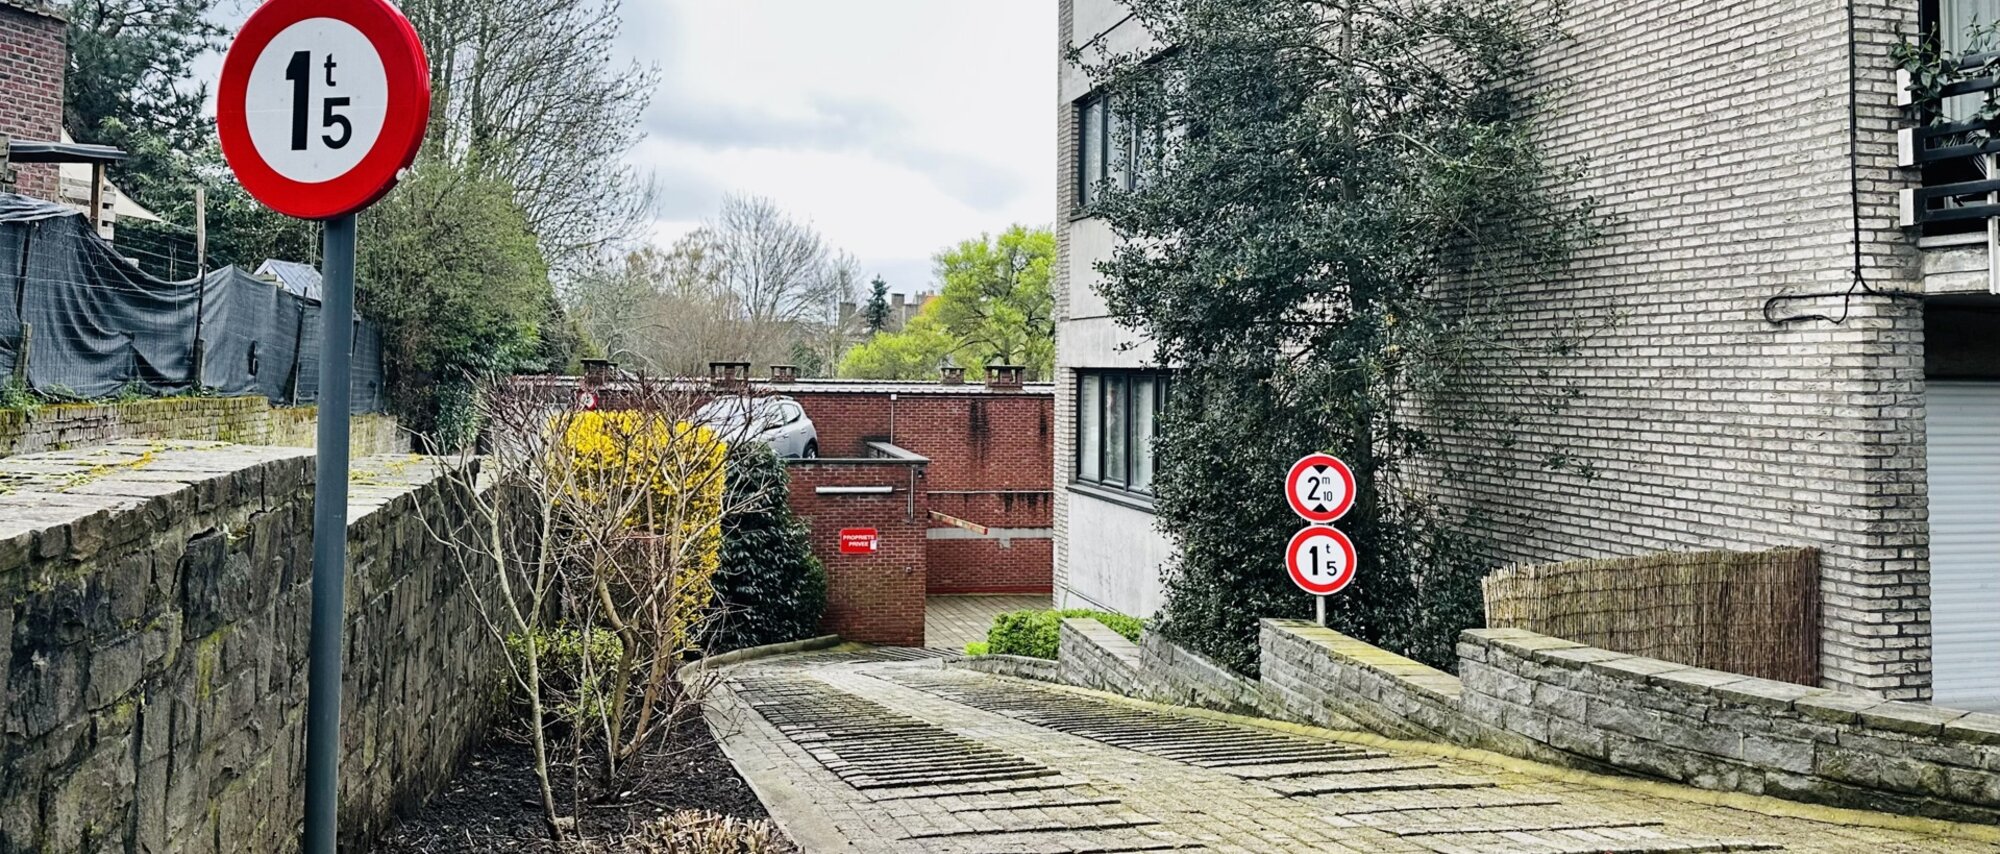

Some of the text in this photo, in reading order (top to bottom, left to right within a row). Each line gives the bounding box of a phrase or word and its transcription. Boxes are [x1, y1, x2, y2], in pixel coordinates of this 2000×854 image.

[285, 50, 353, 151] 1 t 5
[1307, 476, 1333, 502] 2 m 10
[1309, 544, 1338, 577] 1 t 5
